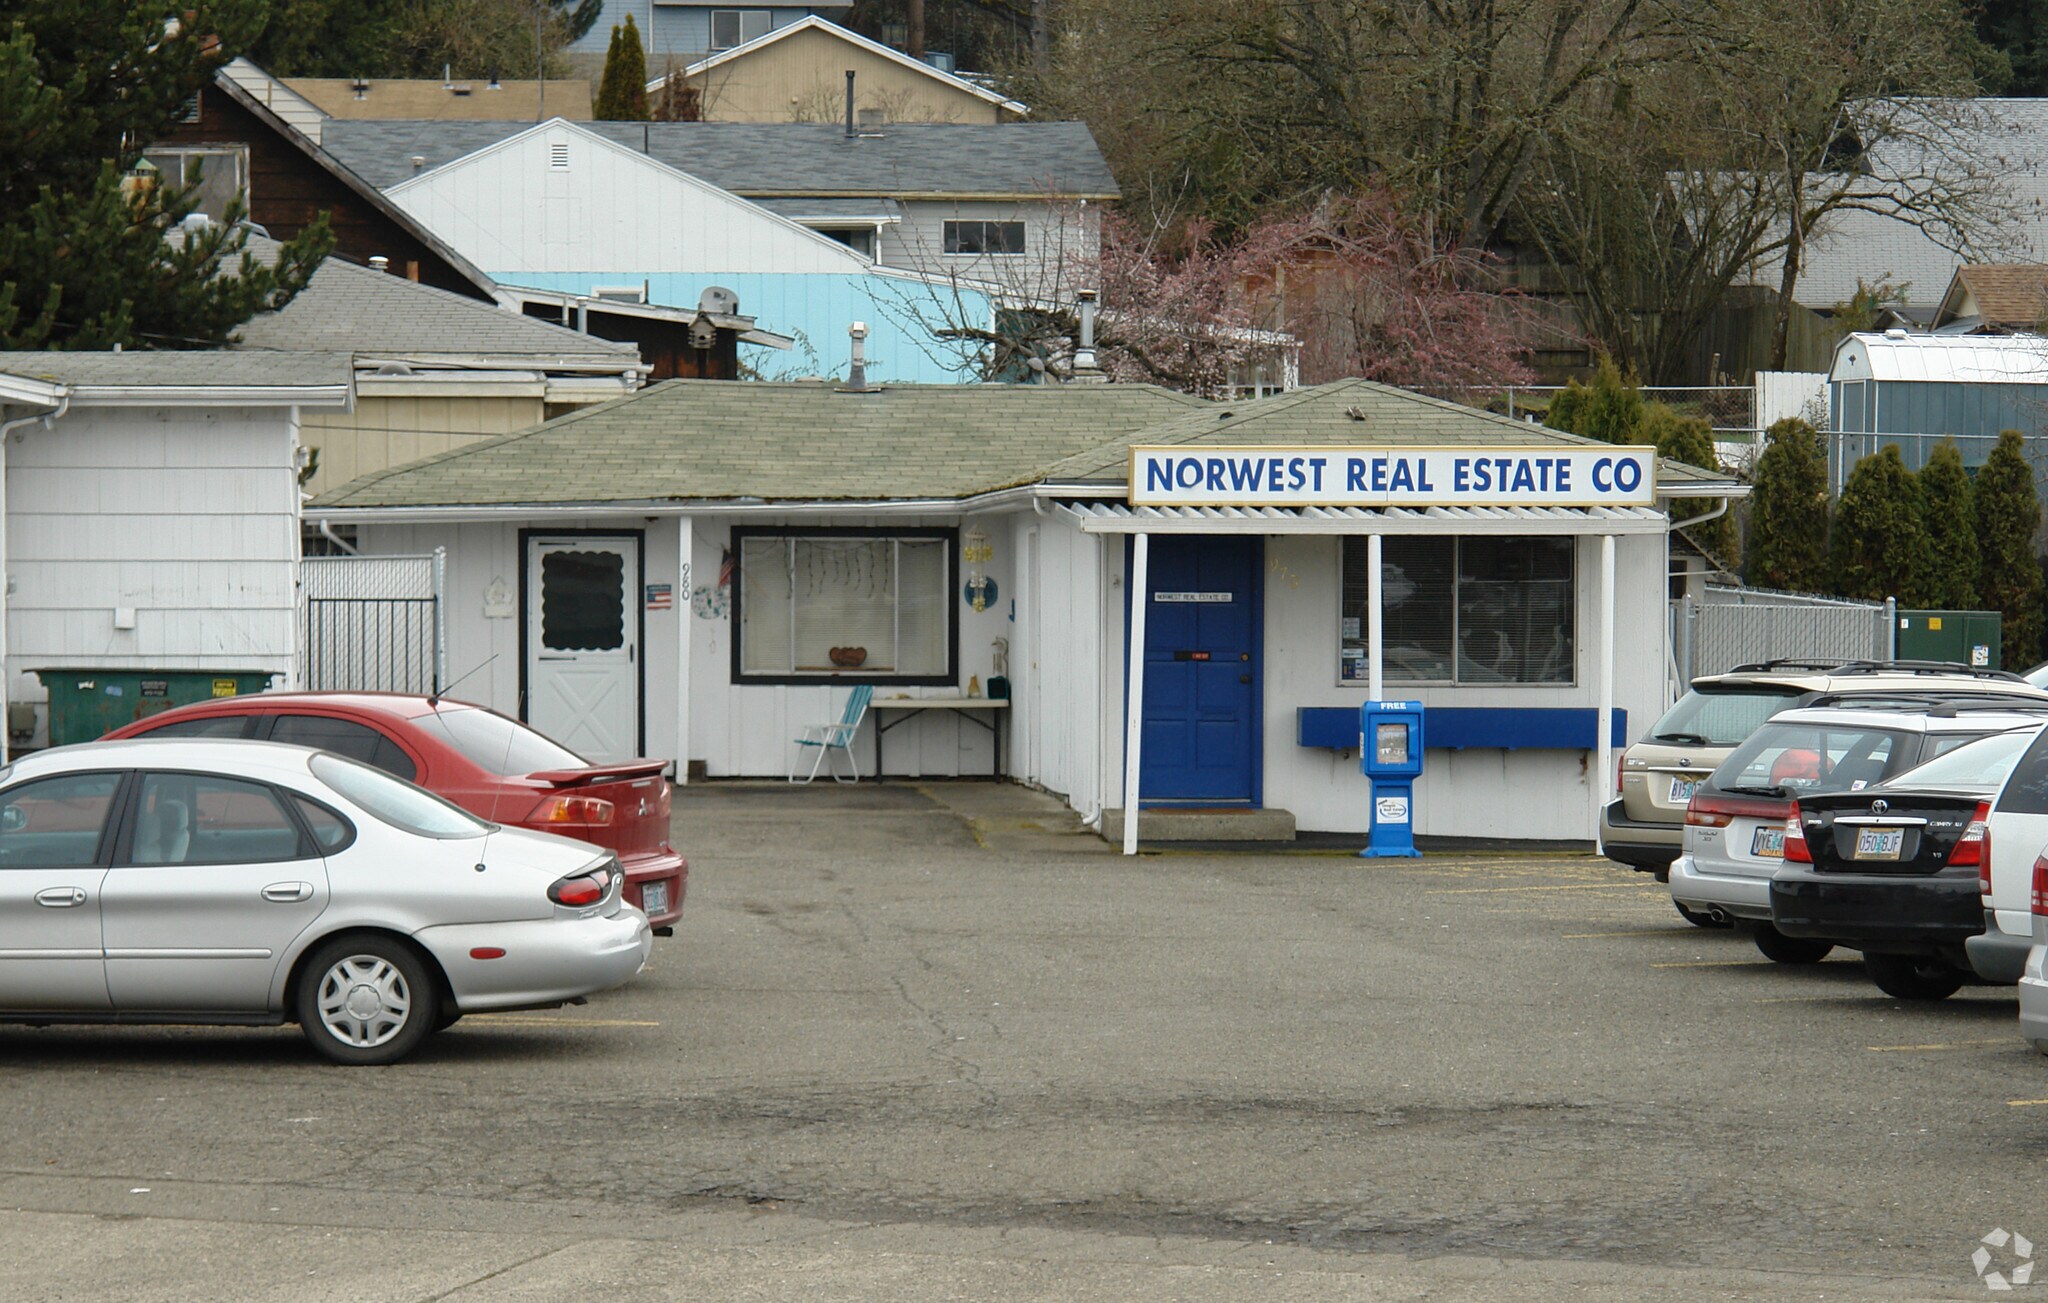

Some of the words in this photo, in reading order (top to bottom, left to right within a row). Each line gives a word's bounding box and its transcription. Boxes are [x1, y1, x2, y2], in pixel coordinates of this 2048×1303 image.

[1146, 456, 1327, 492] NORWEST
[1346, 457, 1434, 492] REAL
[1453, 457, 1572, 492] ESTATE
[1591, 457, 1642, 493] CO
[1156, 593, 1182, 601] NORWEST
[1183, 593, 1197, 601] REAL
[1198, 593, 1219, 601] ESTATE
[1380, 702, 1407, 710] FREE
